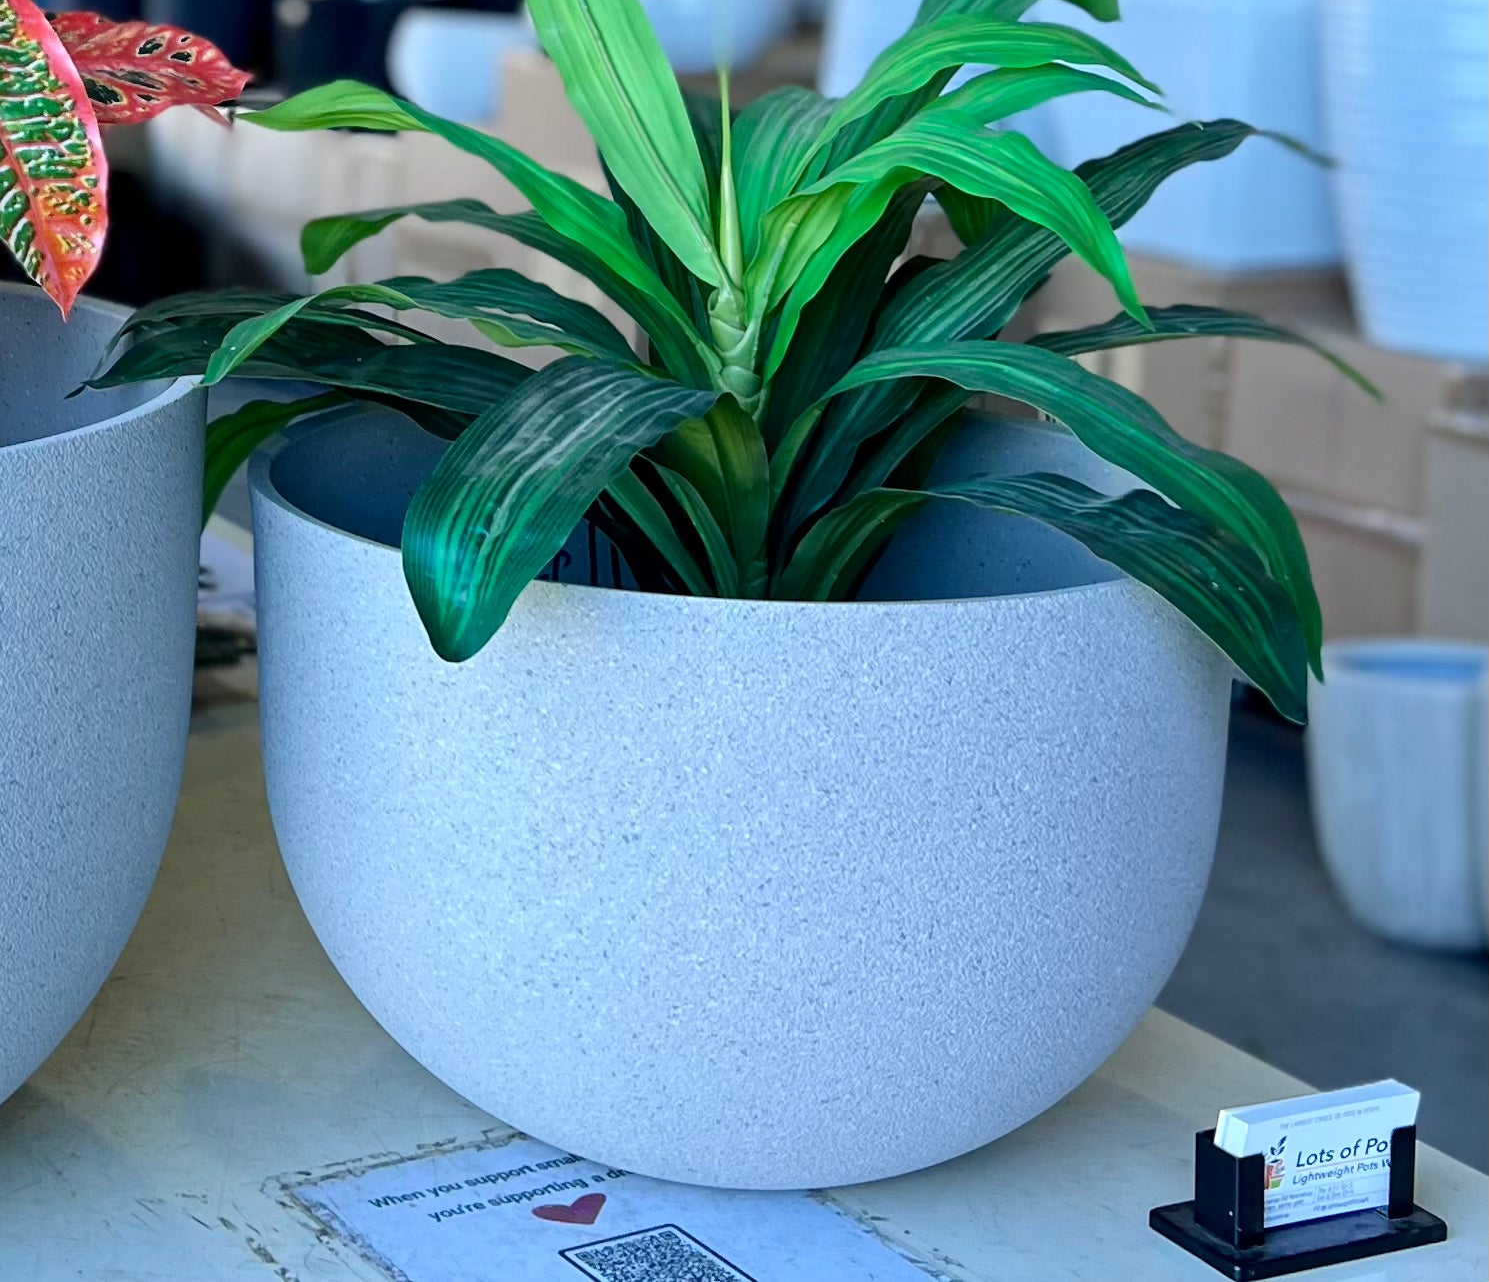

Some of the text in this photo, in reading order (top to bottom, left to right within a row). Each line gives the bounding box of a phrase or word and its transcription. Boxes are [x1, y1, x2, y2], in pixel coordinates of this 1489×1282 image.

[1296, 1137, 1388, 1167] Lots of Po
[368, 1191, 426, 1208] When
[425, 1182, 463, 1198] you
[464, 1164, 537, 1186] support
[1292, 1165, 1354, 1186] Lightweight
[1356, 1161, 1378, 1173] Pots
[427, 1168, 634, 1222] you're supporting a dr
